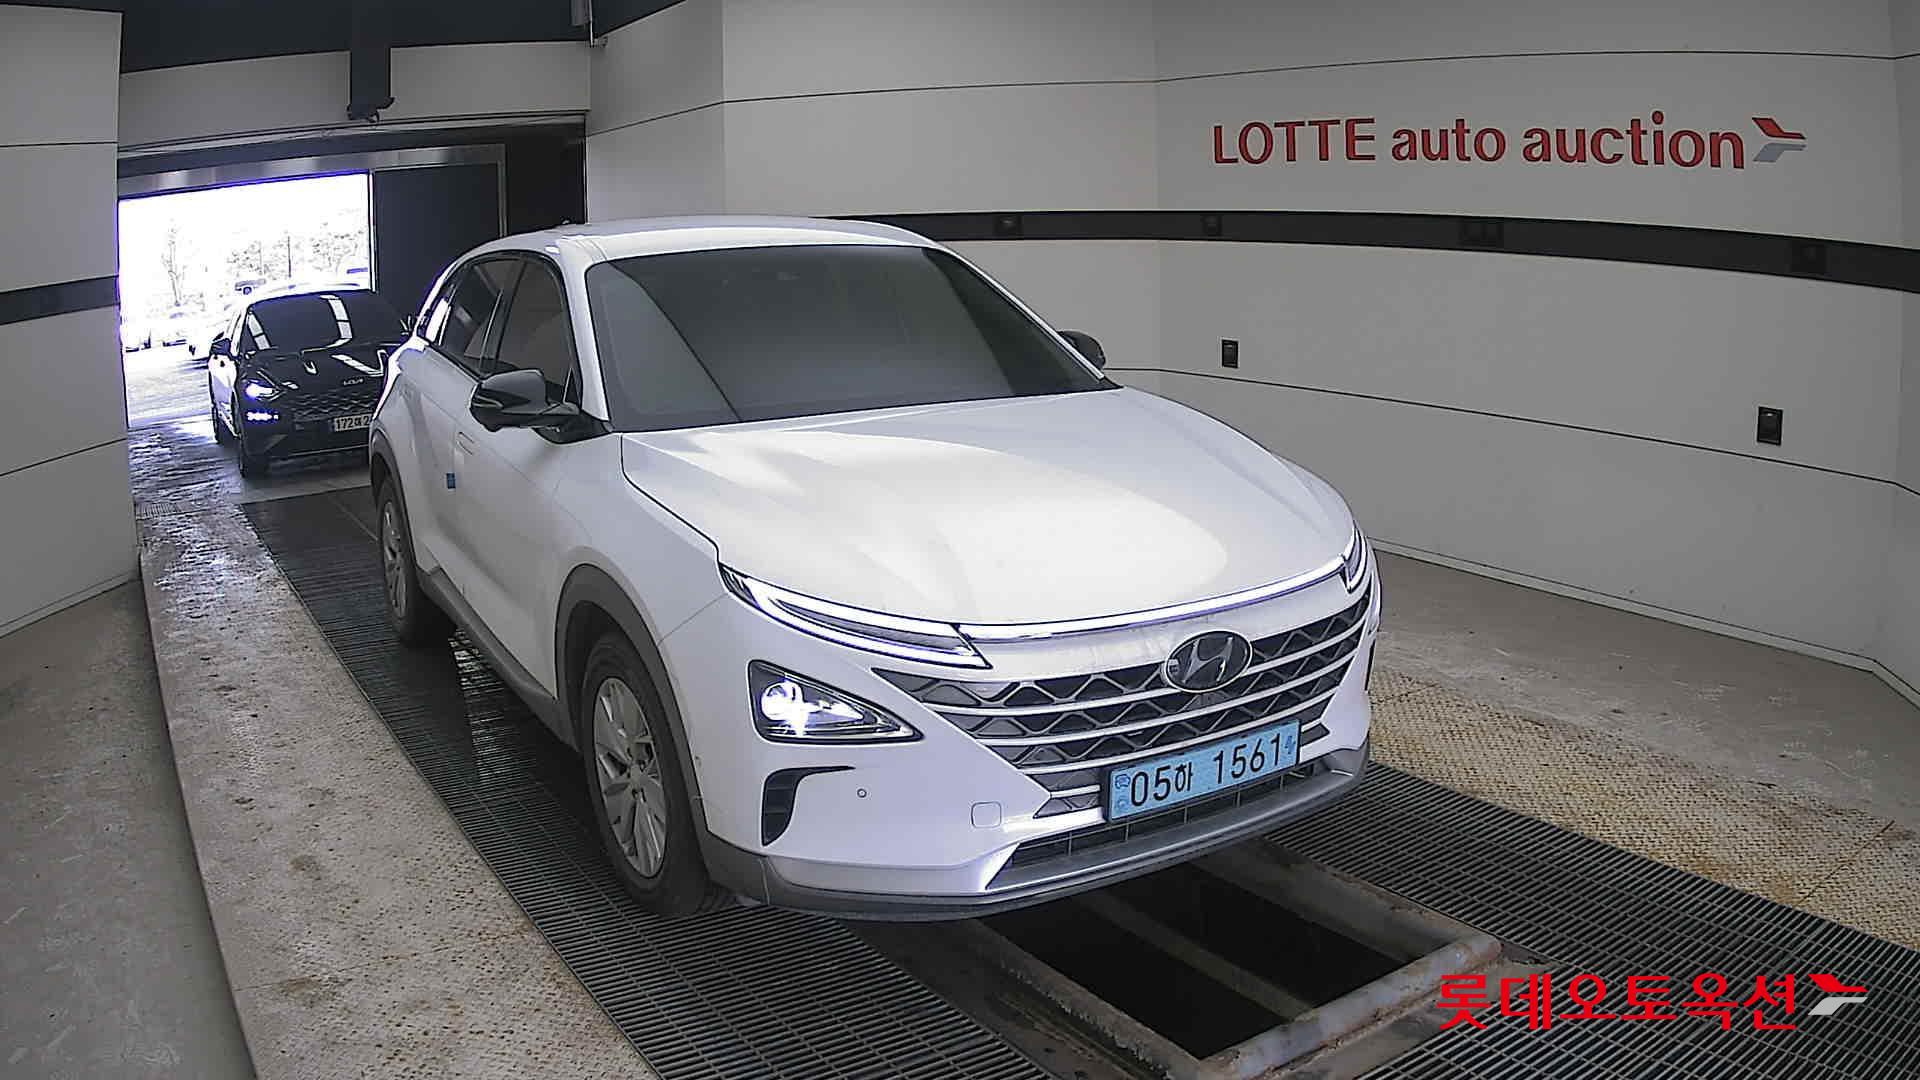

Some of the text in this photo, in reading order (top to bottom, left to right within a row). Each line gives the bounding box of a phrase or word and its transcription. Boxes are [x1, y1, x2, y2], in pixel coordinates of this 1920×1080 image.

[1213, 110, 1745, 169] LOTTE auto auction
[1131, 733, 1281, 806] 05하 1561
